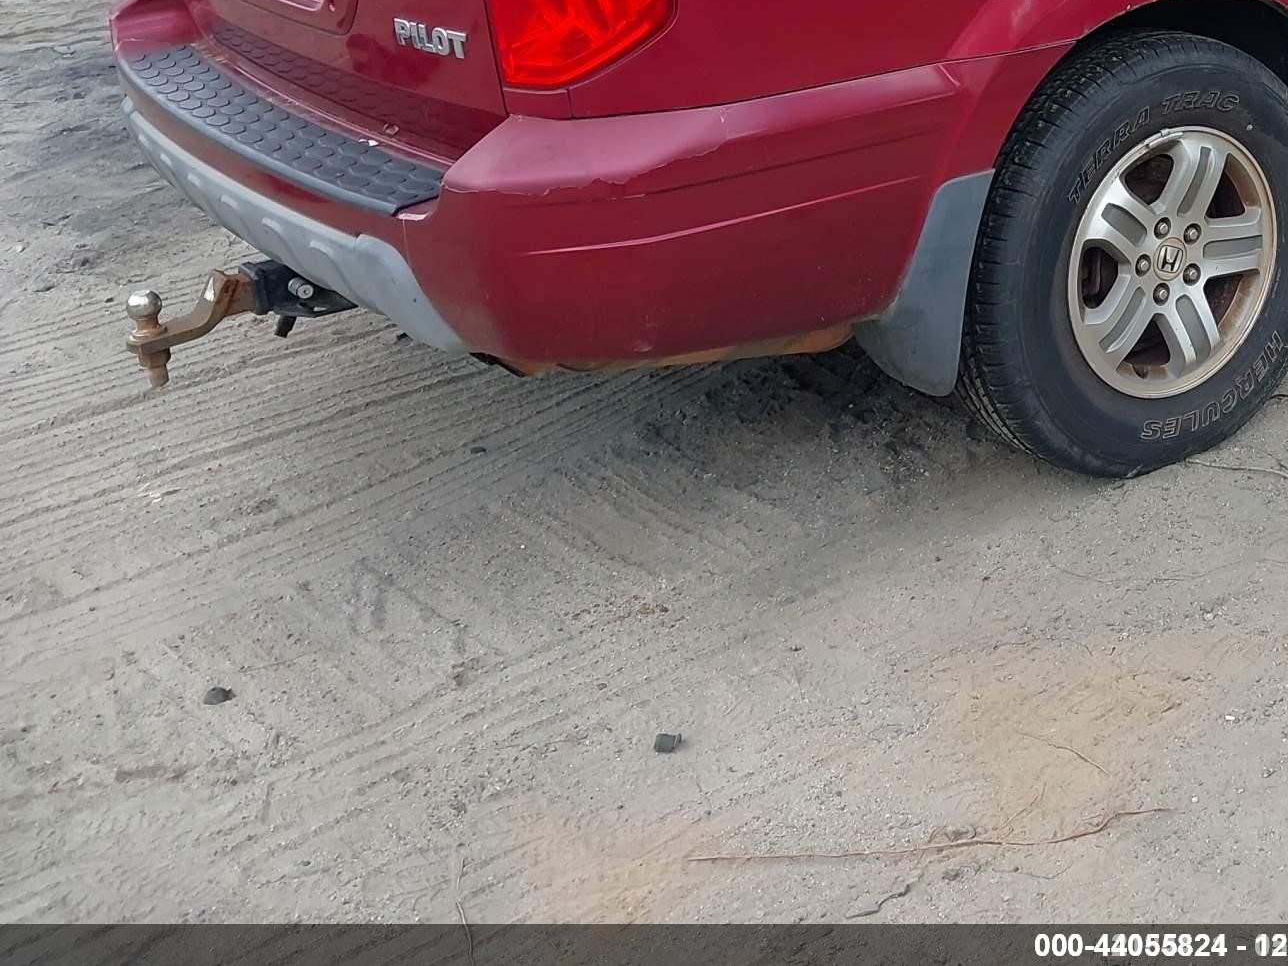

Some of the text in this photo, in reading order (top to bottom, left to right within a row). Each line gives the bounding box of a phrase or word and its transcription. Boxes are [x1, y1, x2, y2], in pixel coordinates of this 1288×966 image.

[393, 17, 468, 59] PILOT
[1068, 90, 1240, 204] TERRA TRAC
[1140, 330, 1285, 441] HERCULES
